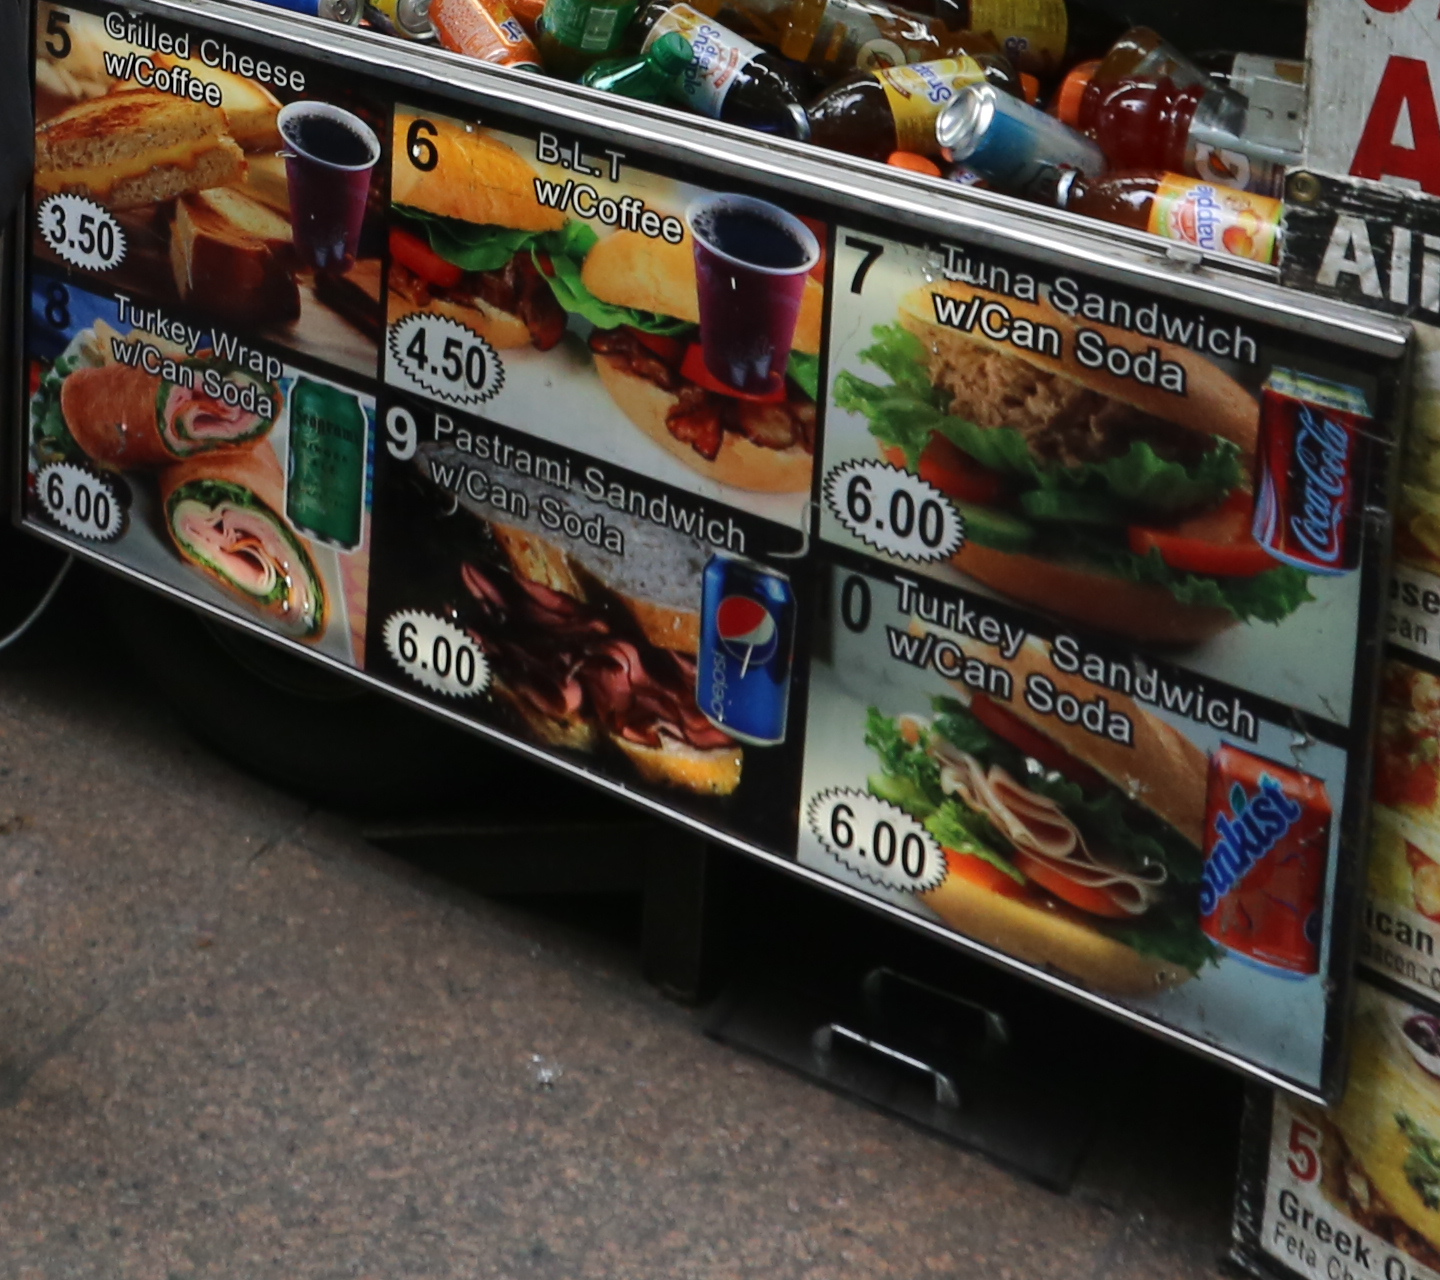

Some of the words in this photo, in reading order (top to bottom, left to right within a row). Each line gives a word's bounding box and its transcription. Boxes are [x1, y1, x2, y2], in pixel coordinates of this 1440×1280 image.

[45, 11, 71, 59] 5
[104, 11, 190, 59] Grilled
[199, 38, 306, 92] Cheese
[104, 51, 222, 107] w/Coffee
[406, 119, 439, 172] 6
[538, 132, 626, 181] B.L.T
[49, 204, 114, 261] 3.50
[533, 177, 683, 243] w/Coffee
[45, 281, 70, 327] 8
[114, 292, 201, 356] Turkey
[210, 331, 283, 382] Wrap
[845, 238, 884, 295] 7
[938, 241, 1036, 302] Tuna
[1049, 276, 1258, 365] Sandwich
[112, 338, 194, 389] w/Can
[203, 370, 273, 419] Soda
[406, 328, 487, 390] 4.50
[933, 292, 1062, 358] w/Can
[1076, 330, 1185, 394] Soda
[47, 472, 111, 531] 6.00
[386, 407, 418, 460] 9
[433, 413, 573, 490] Pastrami
[584, 466, 746, 553] Sandwich
[429, 459, 529, 518] w/Can
[540, 496, 625, 555] Soda
[846, 475, 945, 549] 6.00
[398, 621, 475, 687] 6.00
